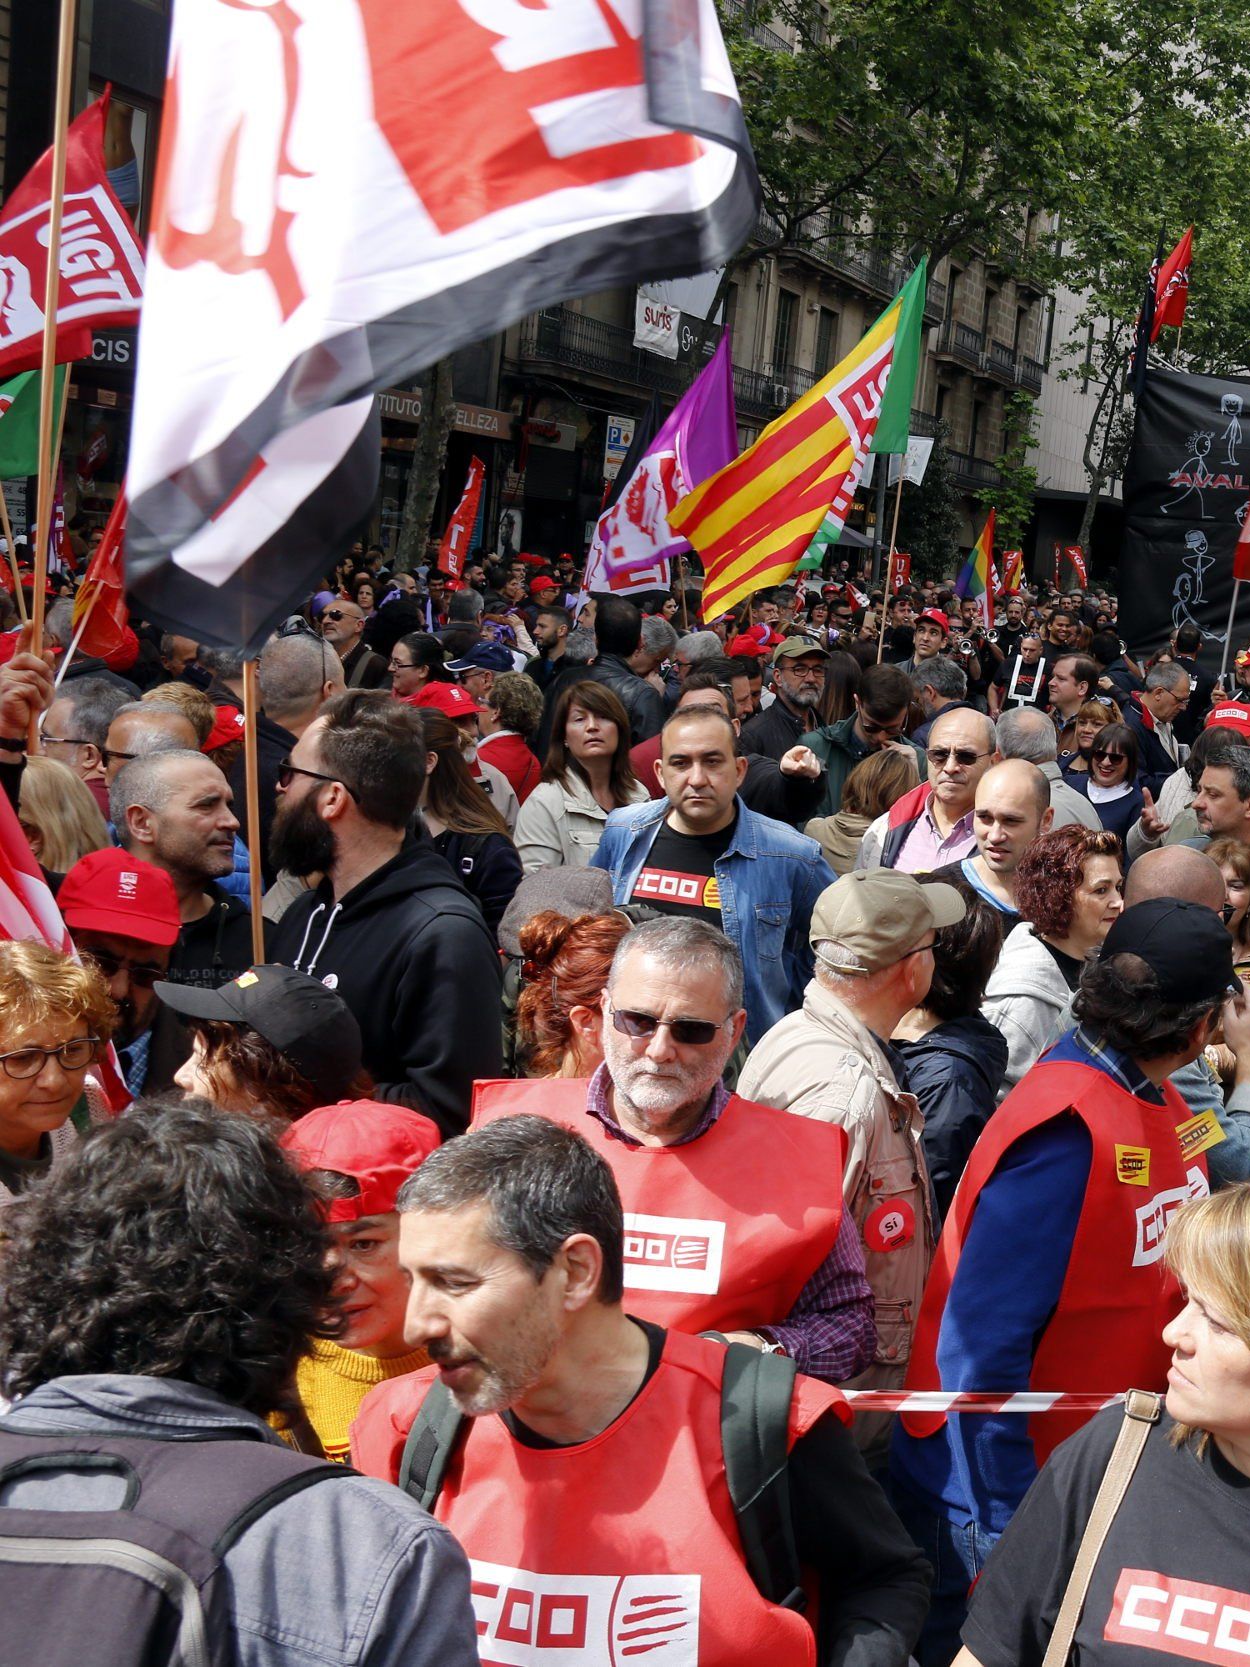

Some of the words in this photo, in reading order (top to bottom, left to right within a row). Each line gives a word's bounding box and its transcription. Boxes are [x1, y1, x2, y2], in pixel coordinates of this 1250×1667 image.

[36, 209, 134, 300] UGT
[644, 304, 673, 332] suris
[84, 338, 130, 363] CIS
